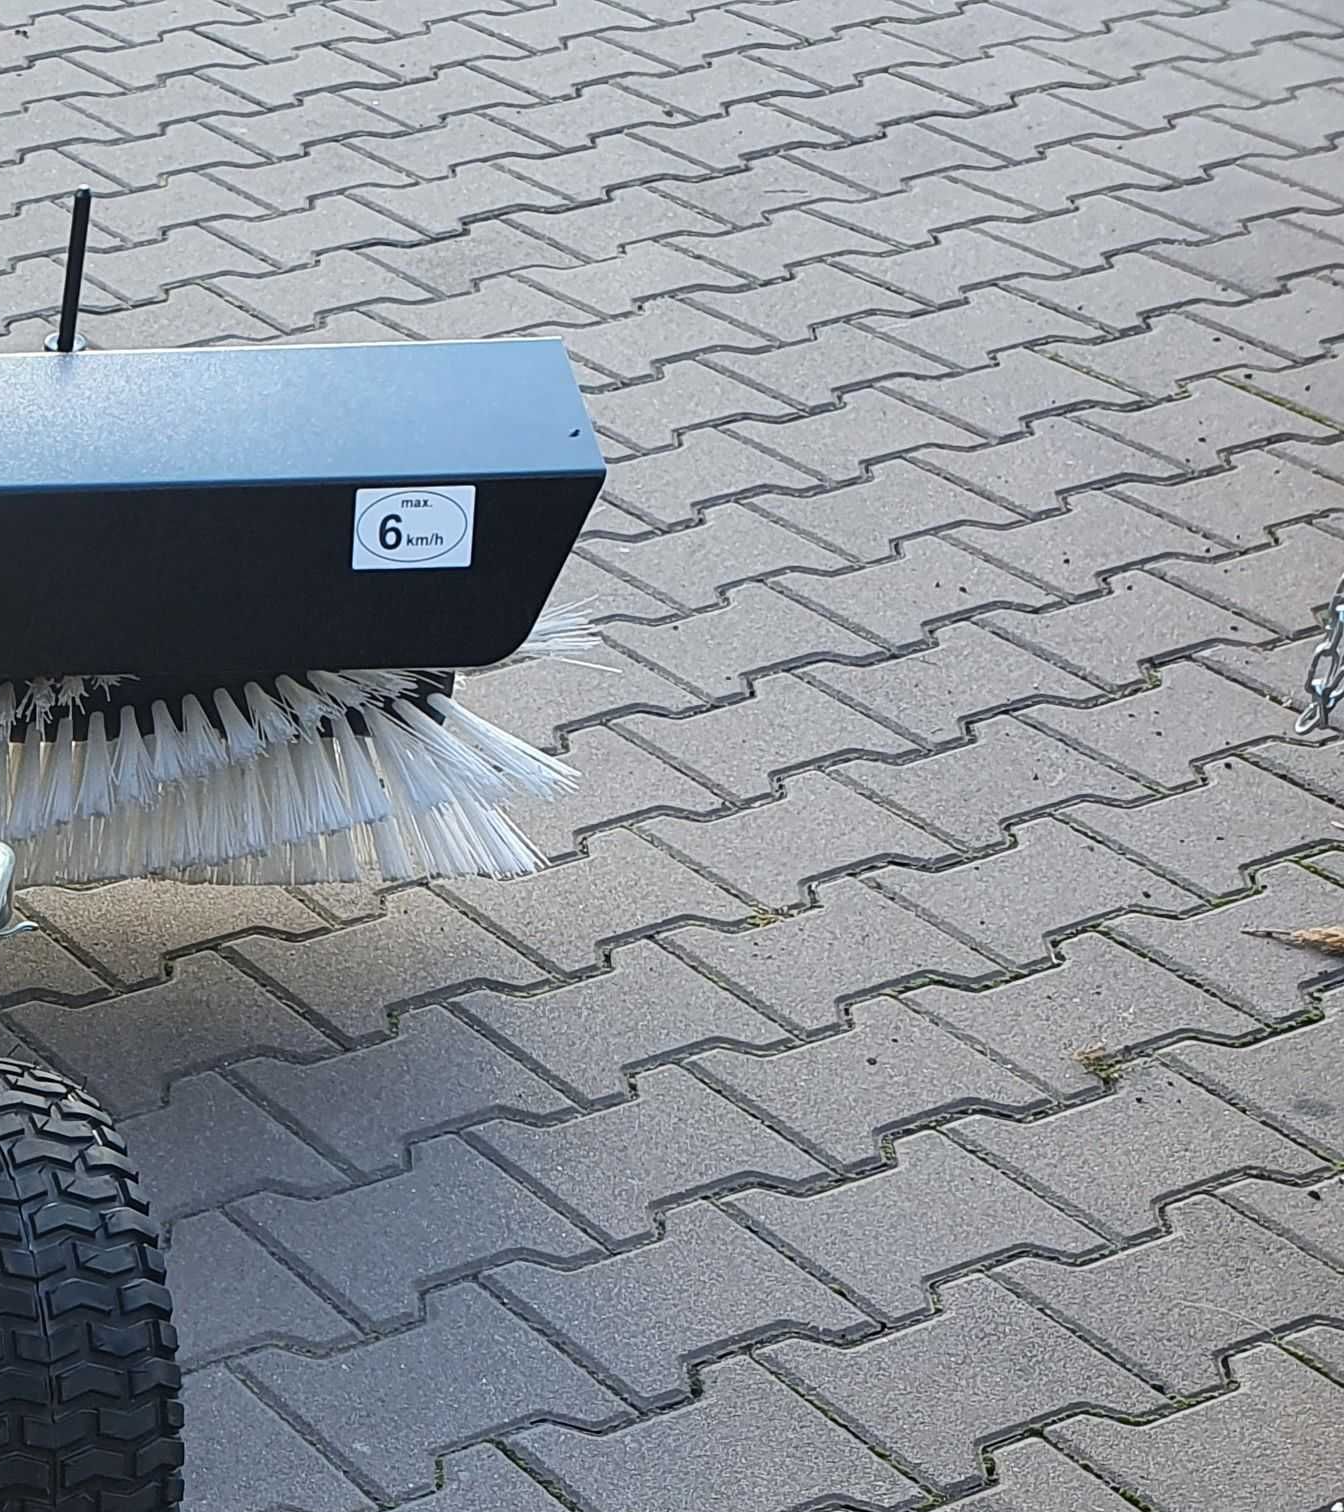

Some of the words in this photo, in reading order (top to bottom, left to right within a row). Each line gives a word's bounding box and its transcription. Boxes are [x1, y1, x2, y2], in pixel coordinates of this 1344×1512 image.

[401, 499, 433, 508] max.
[379, 514, 402, 550] 6
[406, 533, 444, 546] km/h
